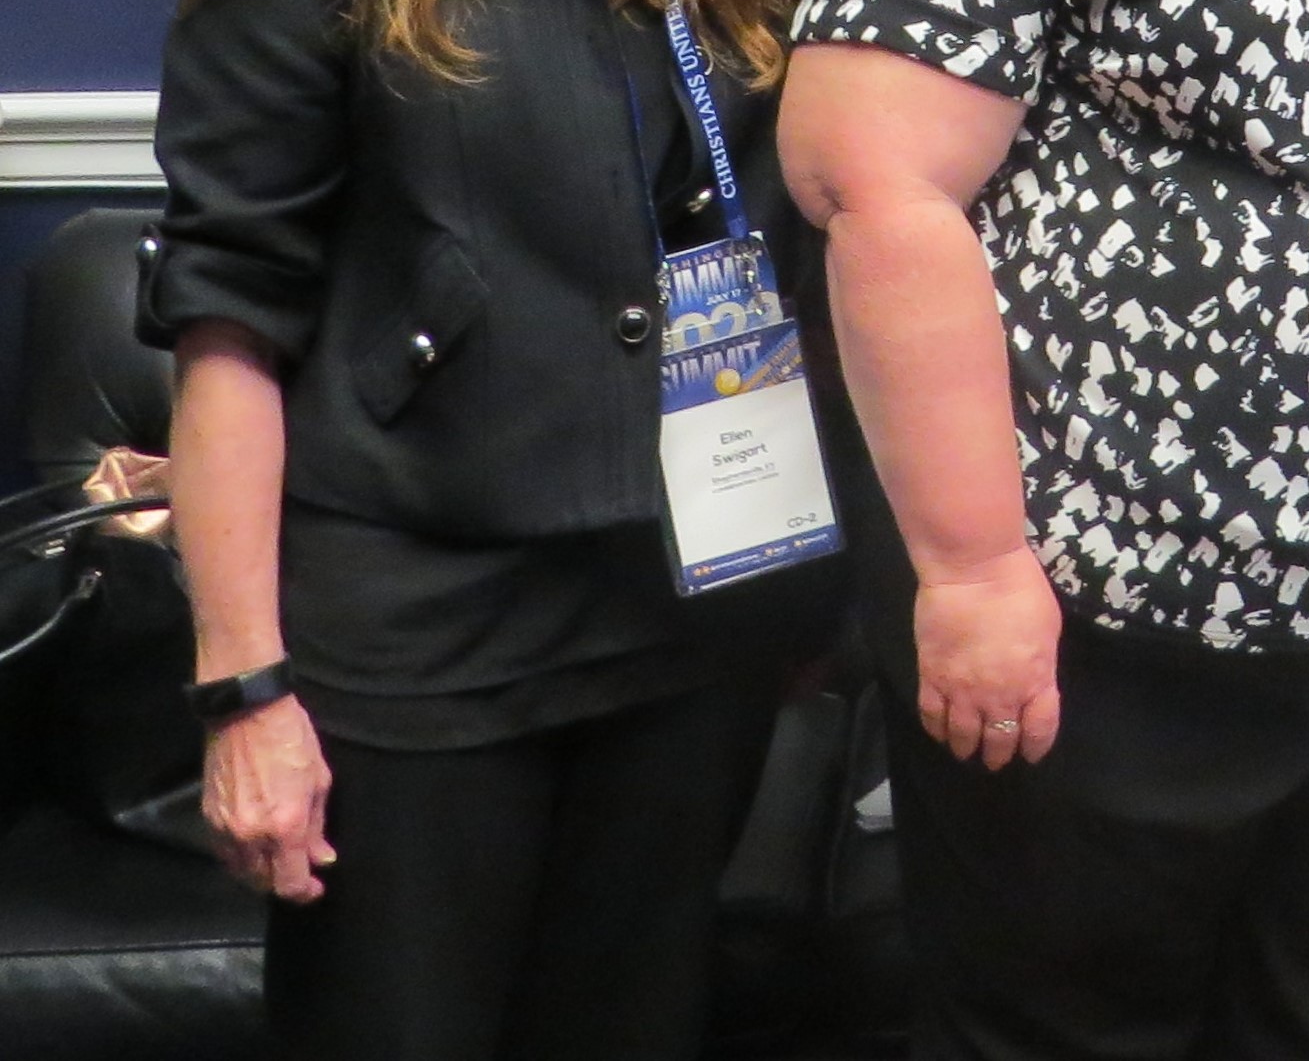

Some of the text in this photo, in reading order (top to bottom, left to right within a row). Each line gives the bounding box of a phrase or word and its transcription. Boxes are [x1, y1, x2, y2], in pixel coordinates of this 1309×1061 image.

[686, 73, 737, 199] CHRISTIANS
[719, 428, 753, 446] Ellen
[711, 442, 769, 467] Swigart
